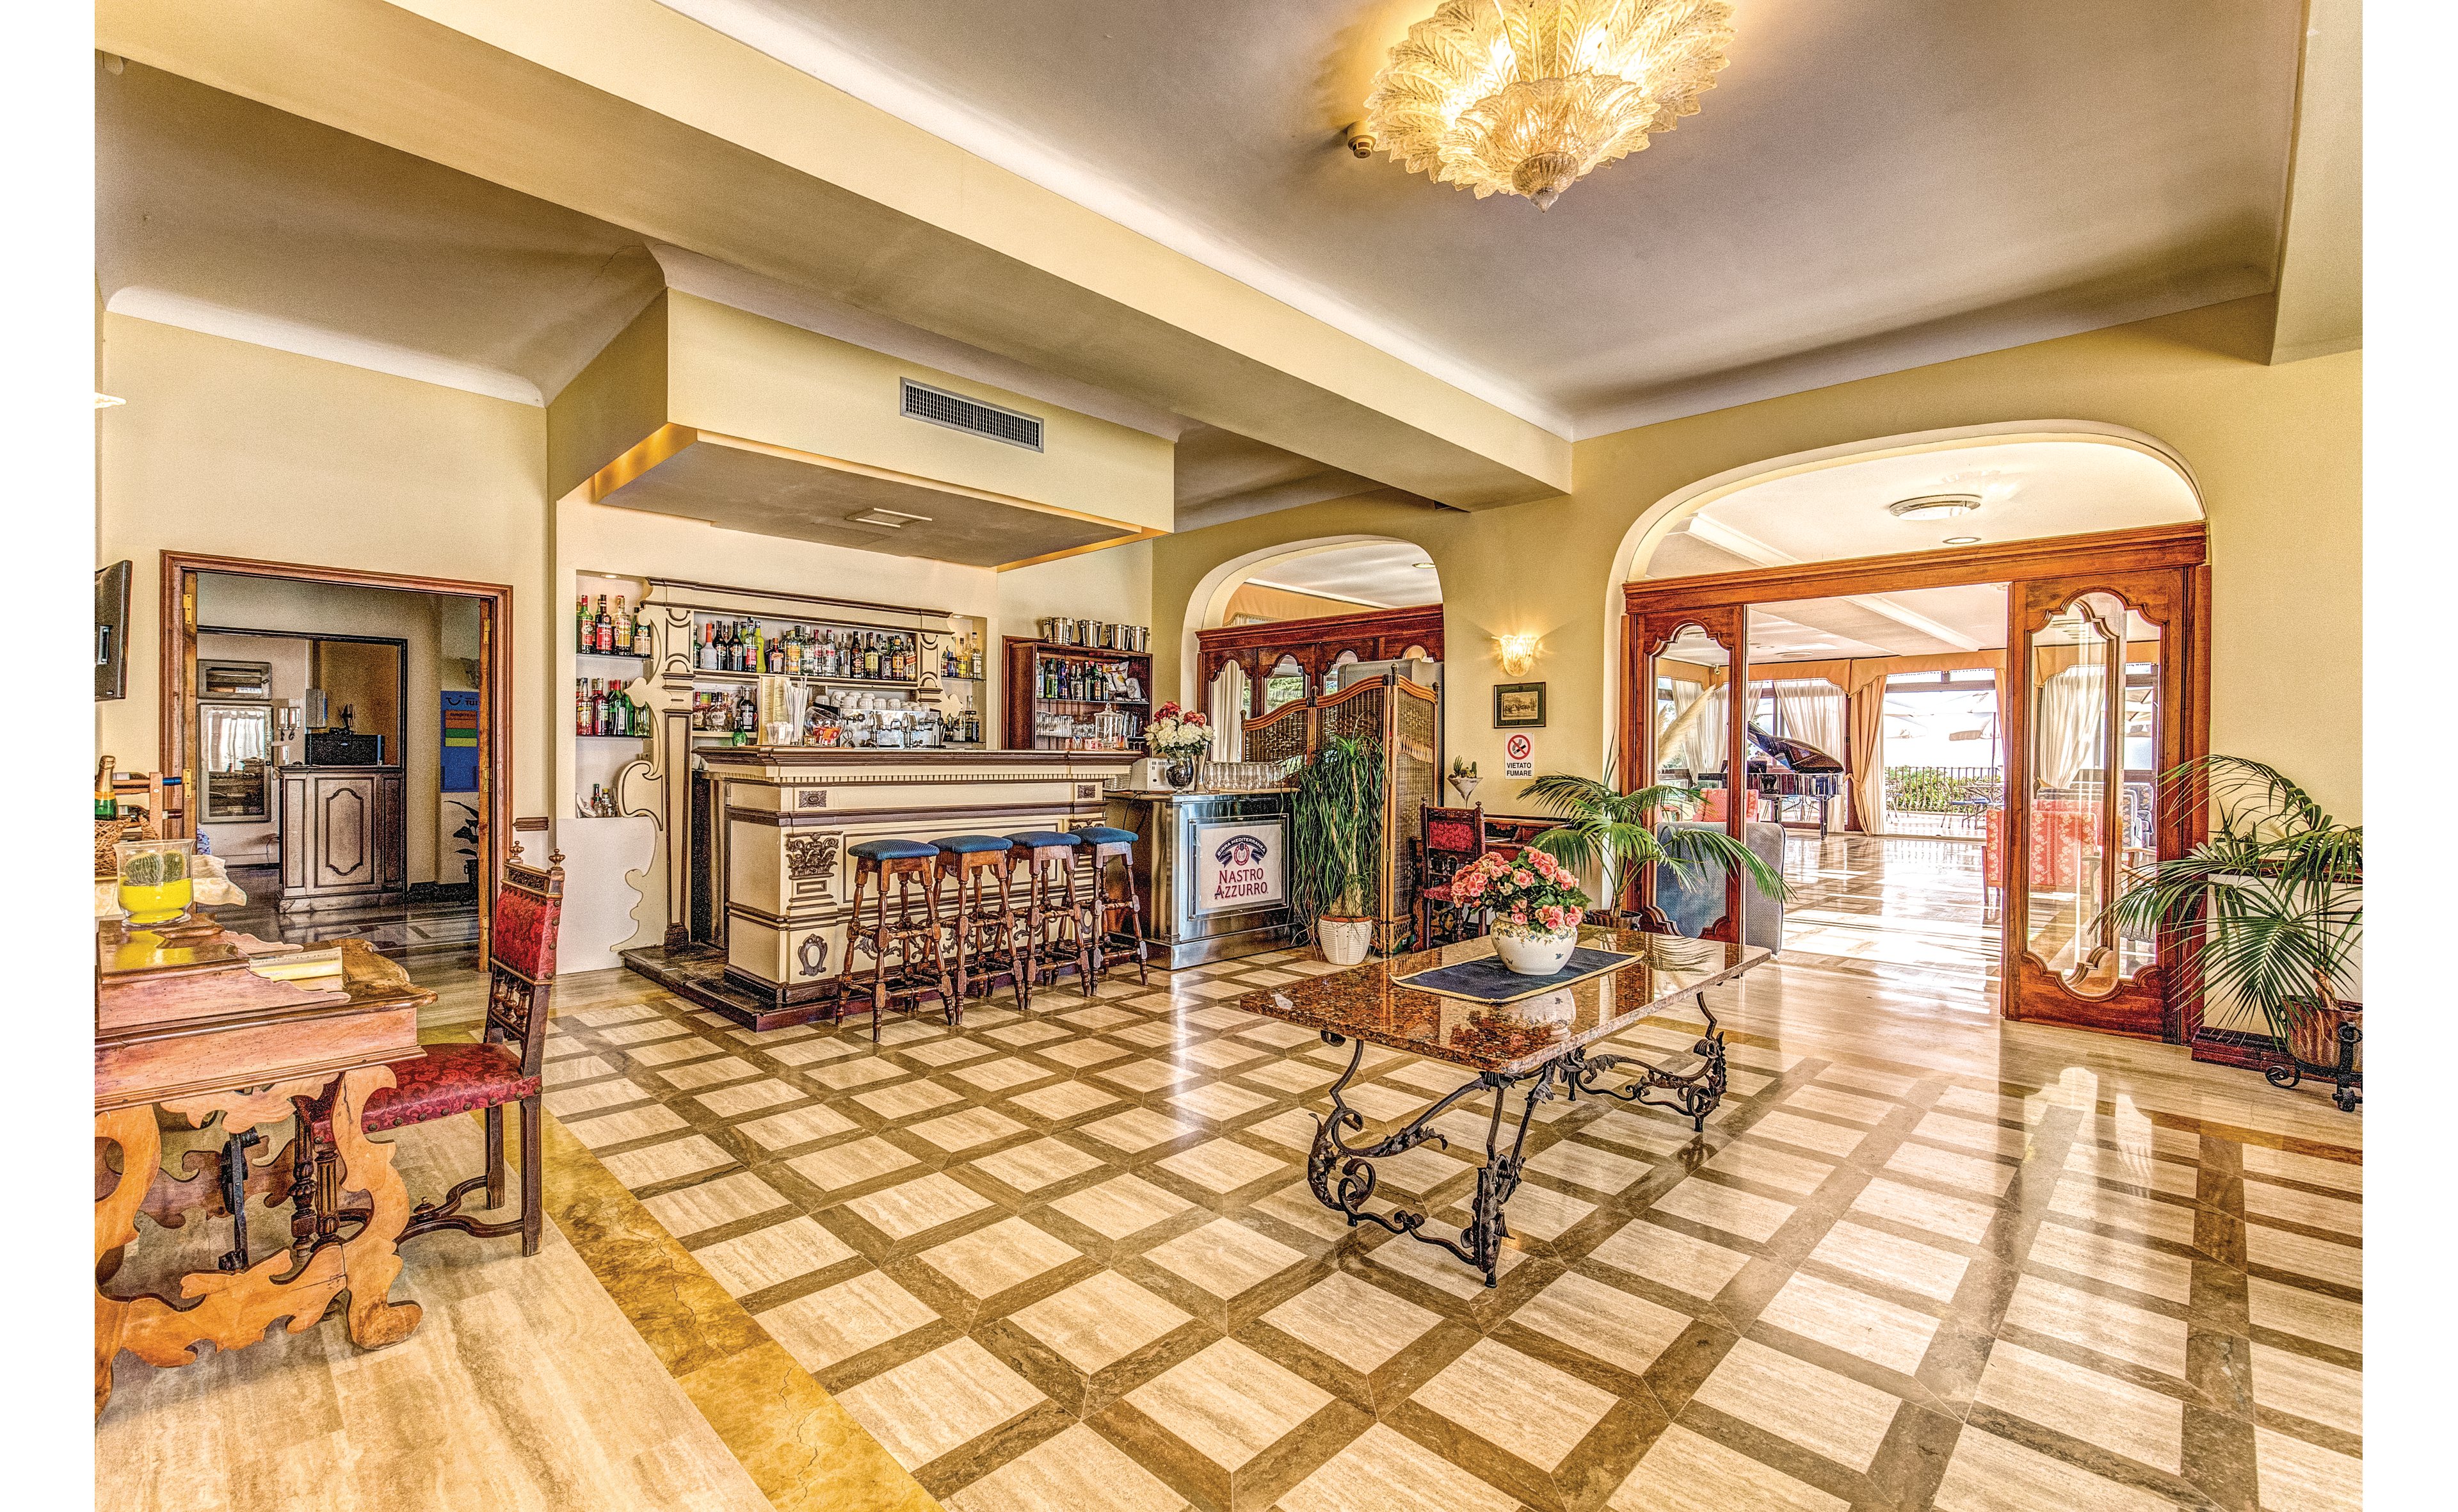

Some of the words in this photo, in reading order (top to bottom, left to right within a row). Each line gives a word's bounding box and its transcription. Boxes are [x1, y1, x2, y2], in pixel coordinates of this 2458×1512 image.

[1217, 842, 1231, 857] BIRRA
[1231, 837, 1265, 853] MEDITERRANEA
[1219, 867, 1264, 884] NASTRO
[1214, 881, 1267, 899] AZZURRO
